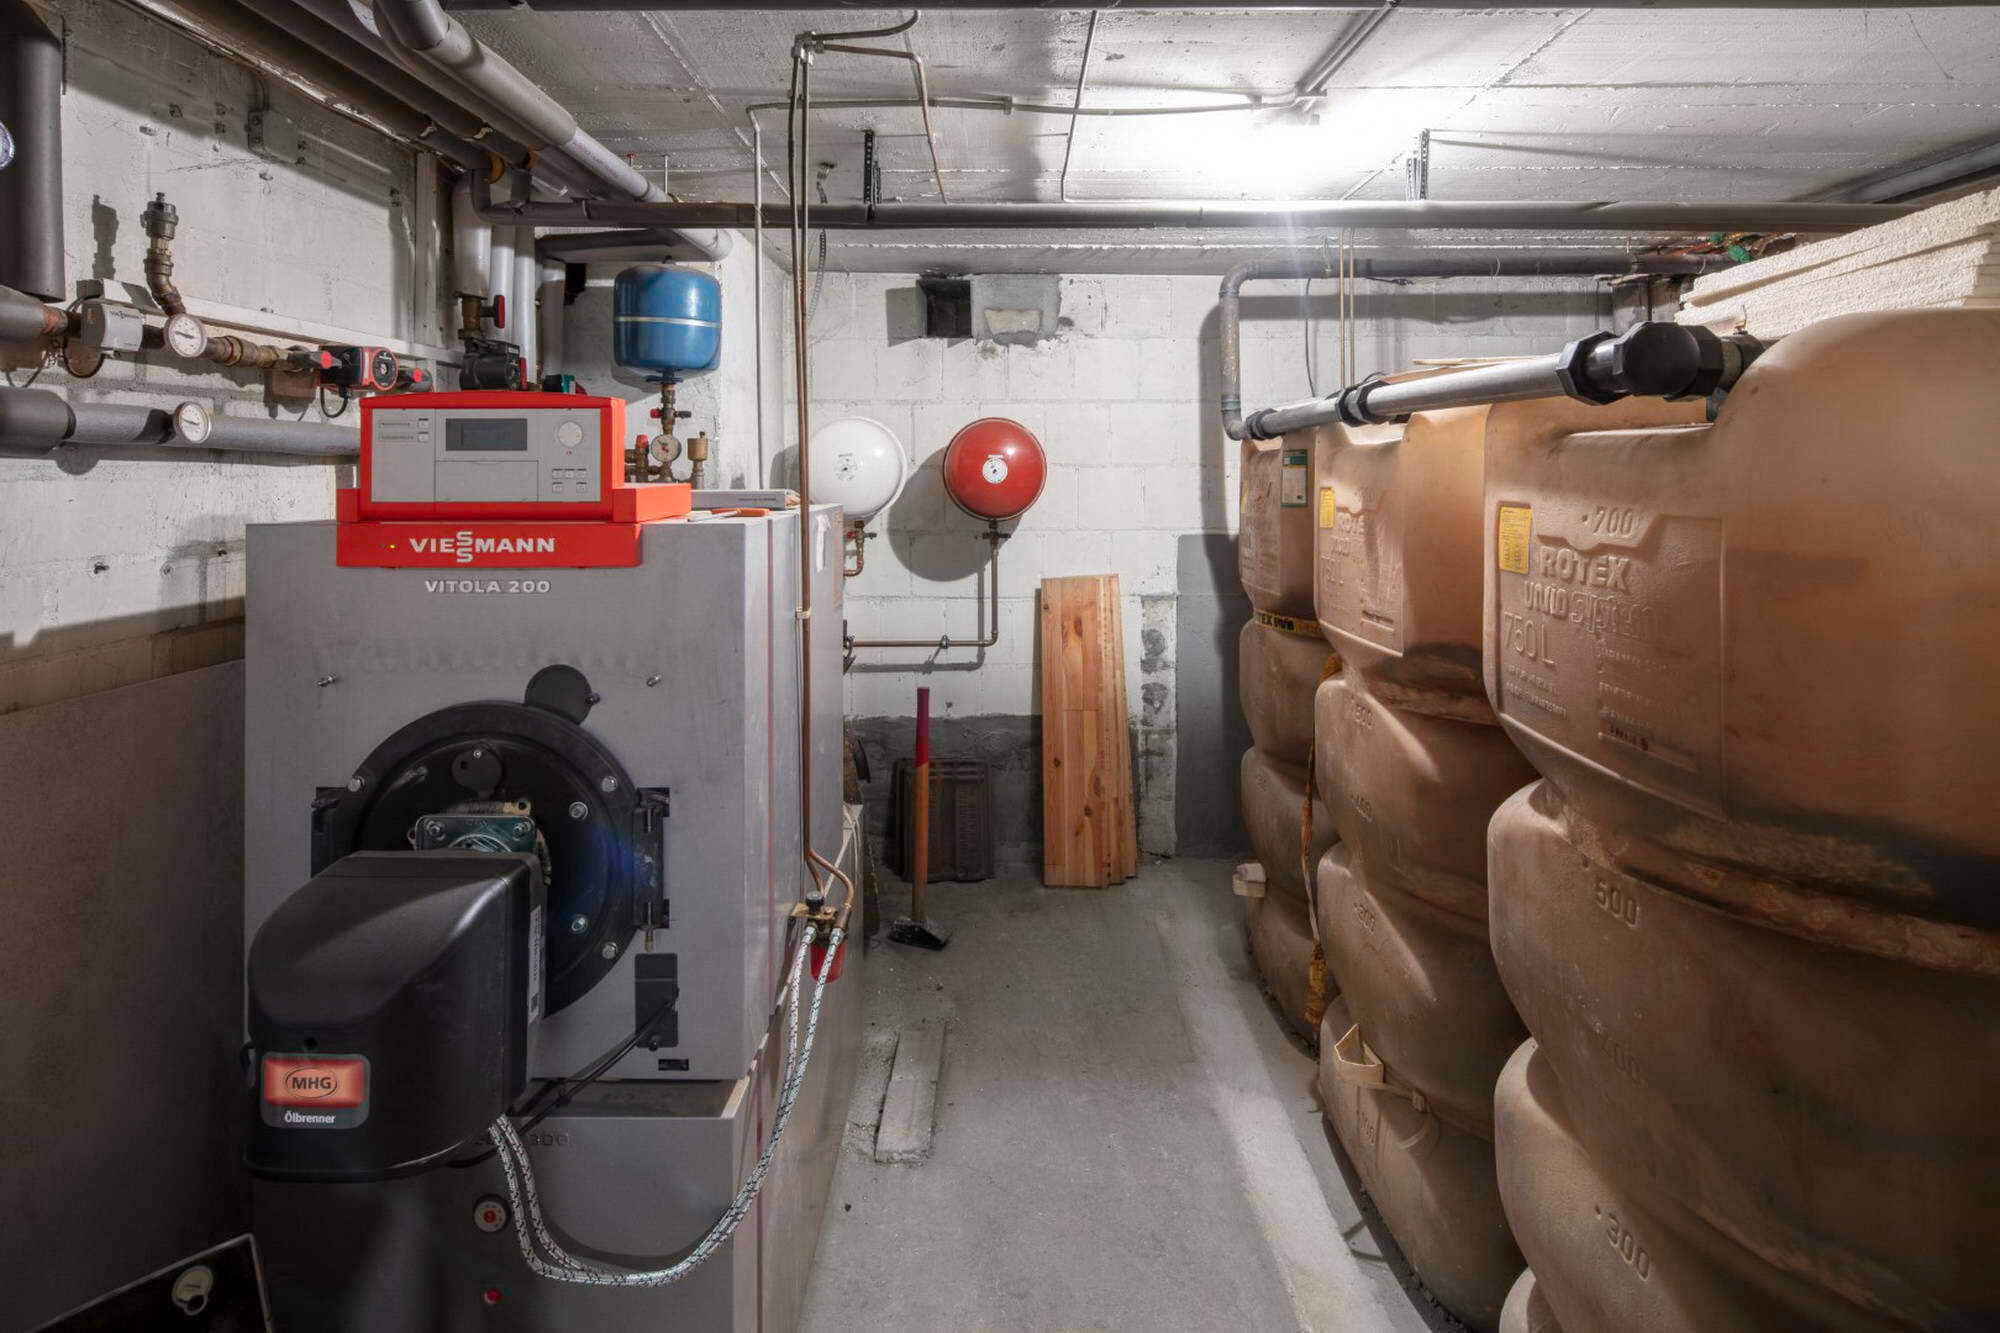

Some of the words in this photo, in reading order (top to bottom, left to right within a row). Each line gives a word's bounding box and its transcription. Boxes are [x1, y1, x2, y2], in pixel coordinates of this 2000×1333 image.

[409, 531, 556, 563] VIESSMANN
[1538, 546, 1631, 589] ROTEX
[424, 580, 501, 593] VITOLA
[508, 580, 551, 593] 200
[1596, 877, 1640, 928] 500
[291, 1077, 331, 1090] MHG
[284, 1110, 336, 1124] Ölbrenner
[1606, 1212, 1650, 1282] 300
